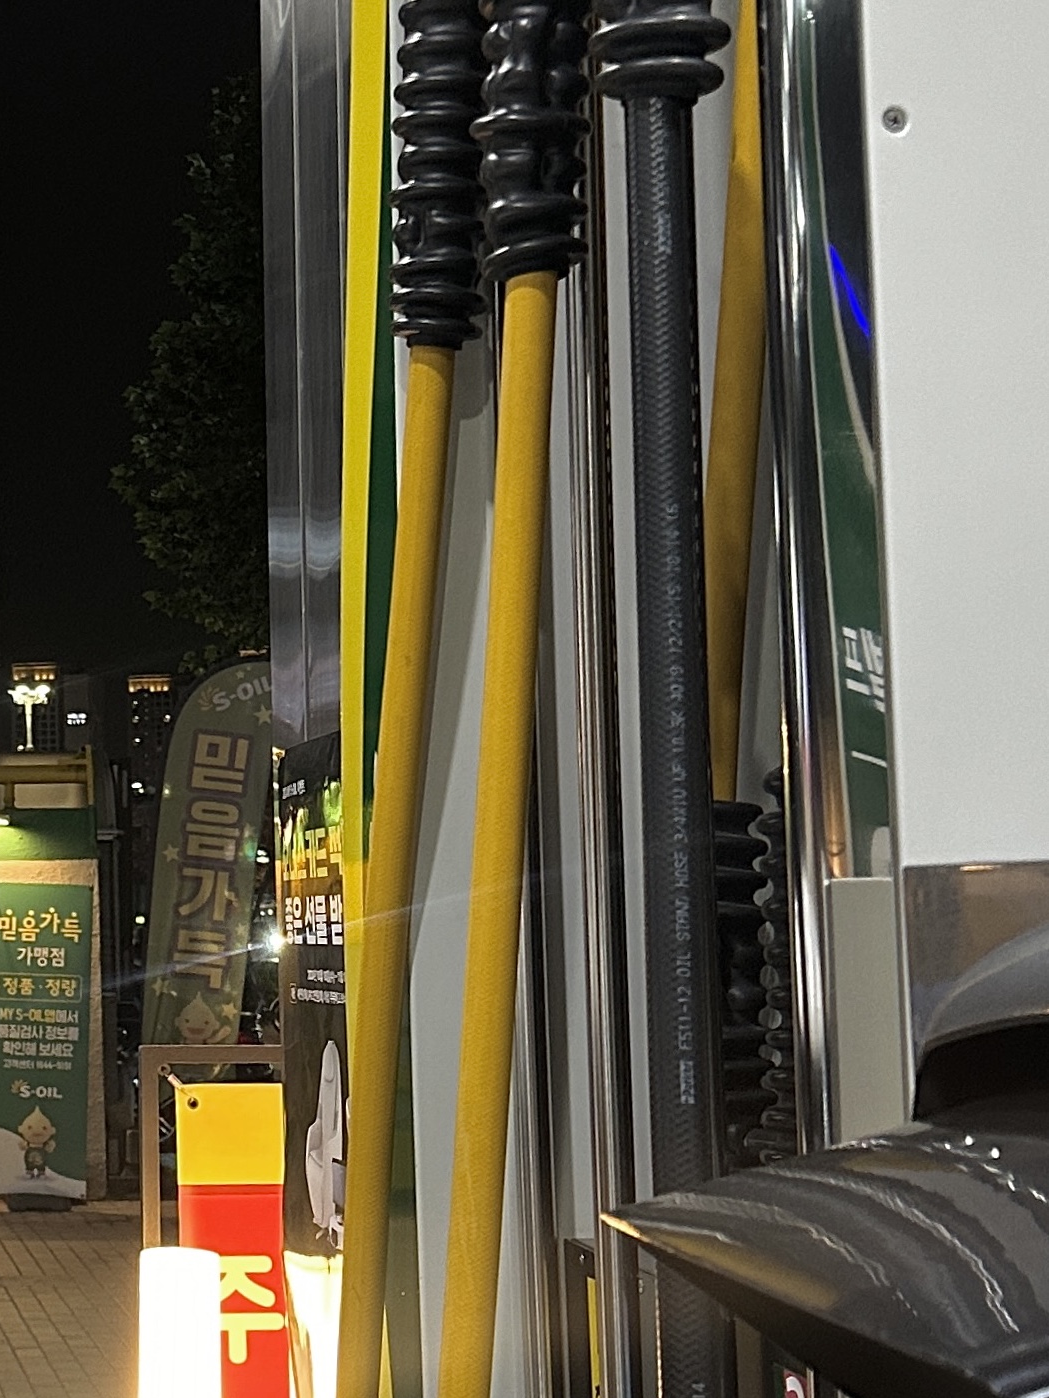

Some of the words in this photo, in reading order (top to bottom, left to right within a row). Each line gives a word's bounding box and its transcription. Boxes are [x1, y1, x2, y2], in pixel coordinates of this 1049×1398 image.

[171, 732, 250, 990] 믿음가득
[284, 896, 304, 945] 좋은
[305, 895, 329, 945] 선물
[16, 946, 65, 967] 가맹점
[675, 950, 692, 977] OIL
[2, 977, 35, 996] 정품
[45, 978, 77, 997] 정량
[38, 1042, 74, 1057] 보세요
[19, 1084, 63, 1099] S-OIL
